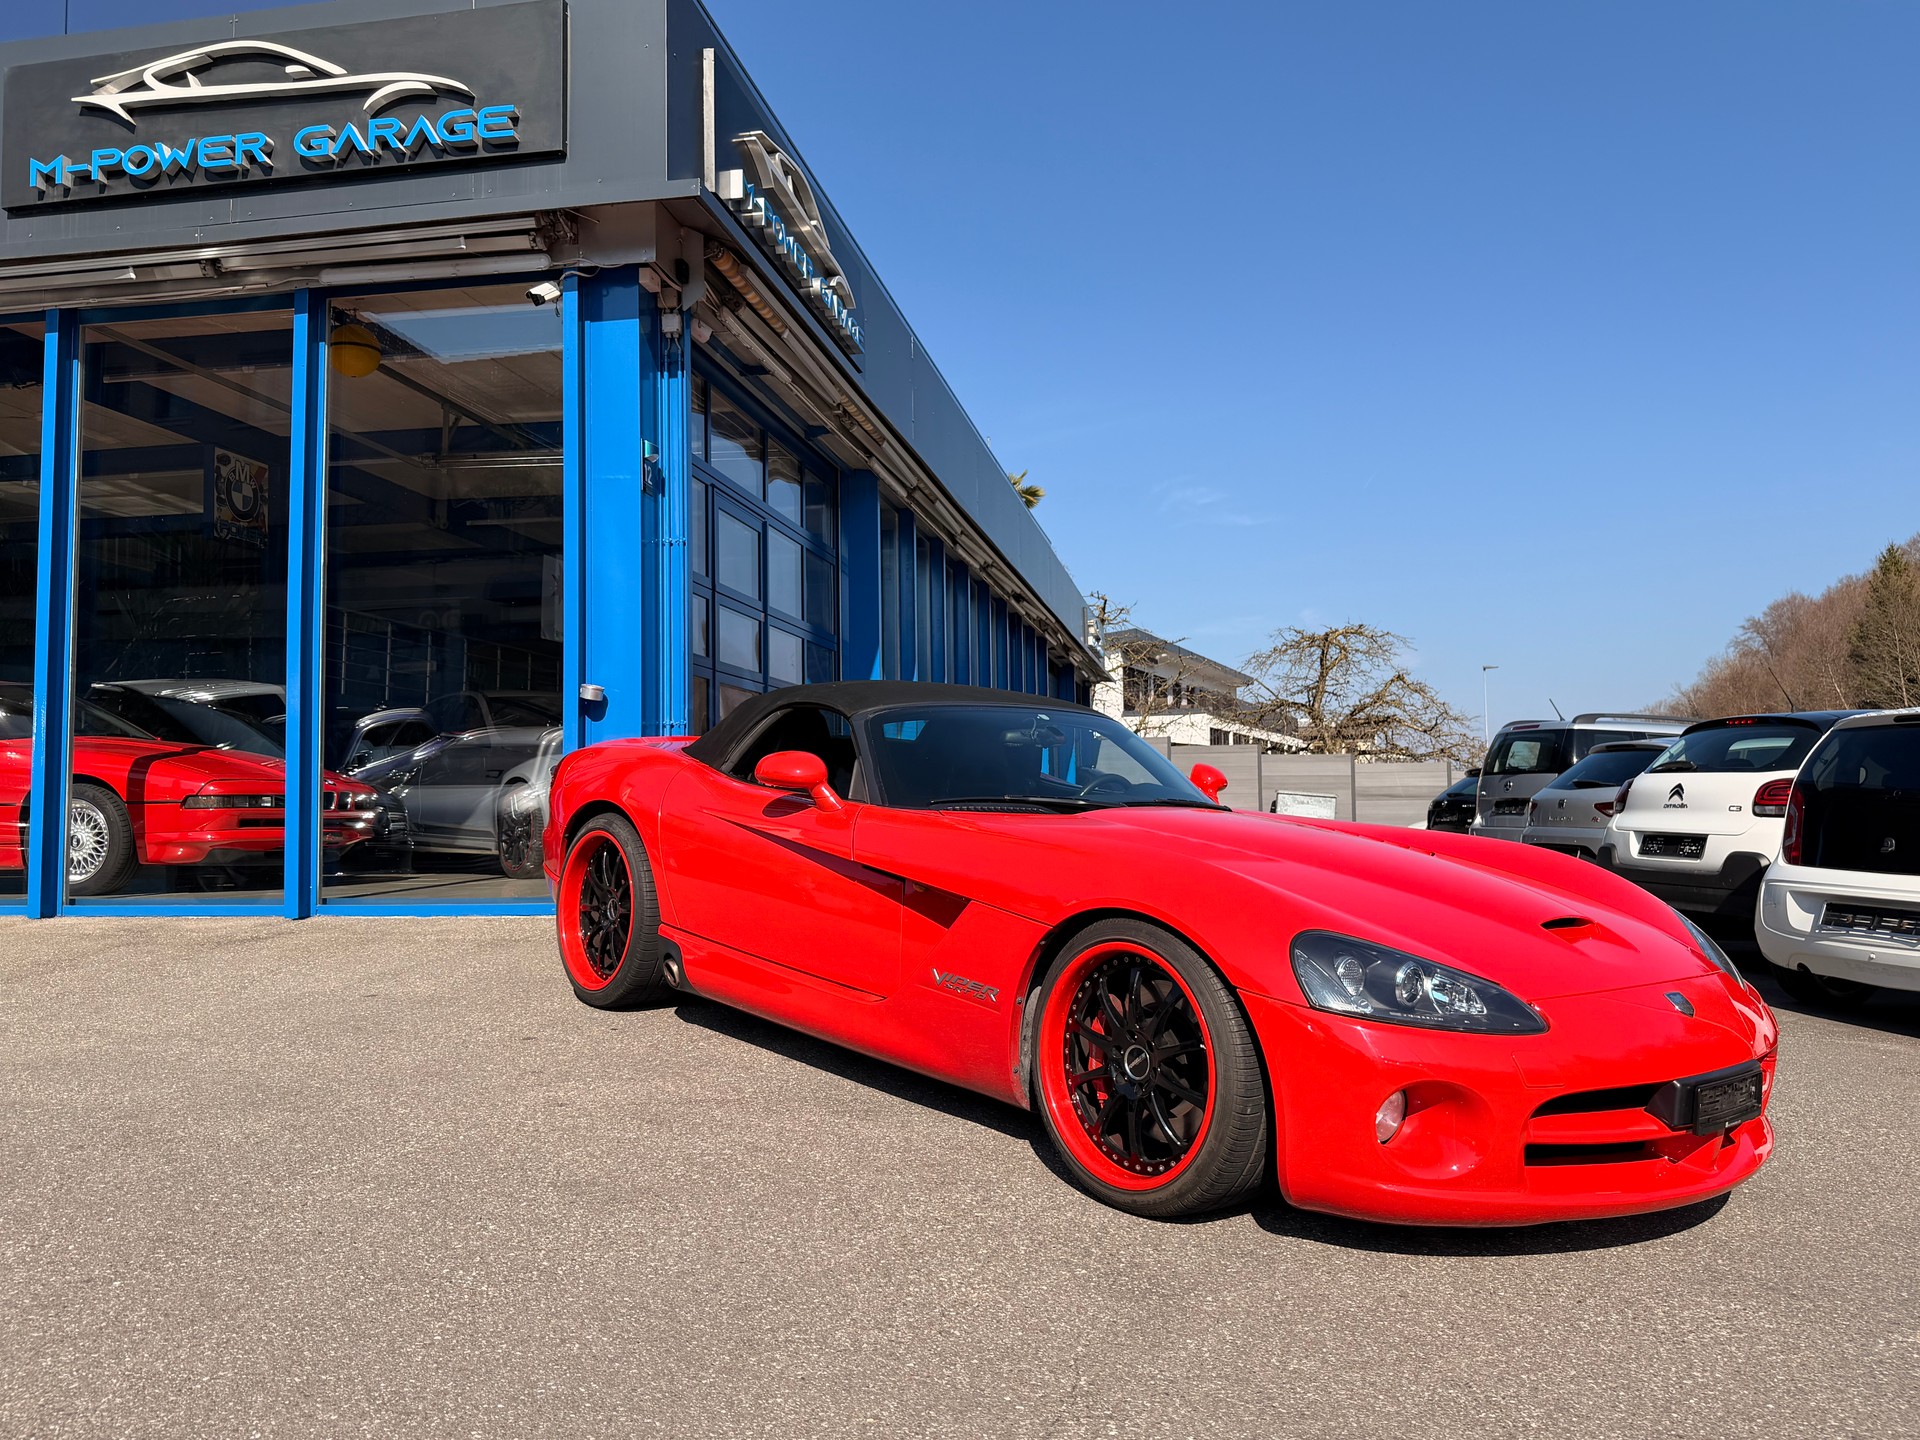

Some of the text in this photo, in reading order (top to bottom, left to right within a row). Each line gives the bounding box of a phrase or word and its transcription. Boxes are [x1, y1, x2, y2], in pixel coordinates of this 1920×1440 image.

[29, 104, 515, 187] M-POWER GARAGE
[931, 968, 1000, 1002] VIPER
